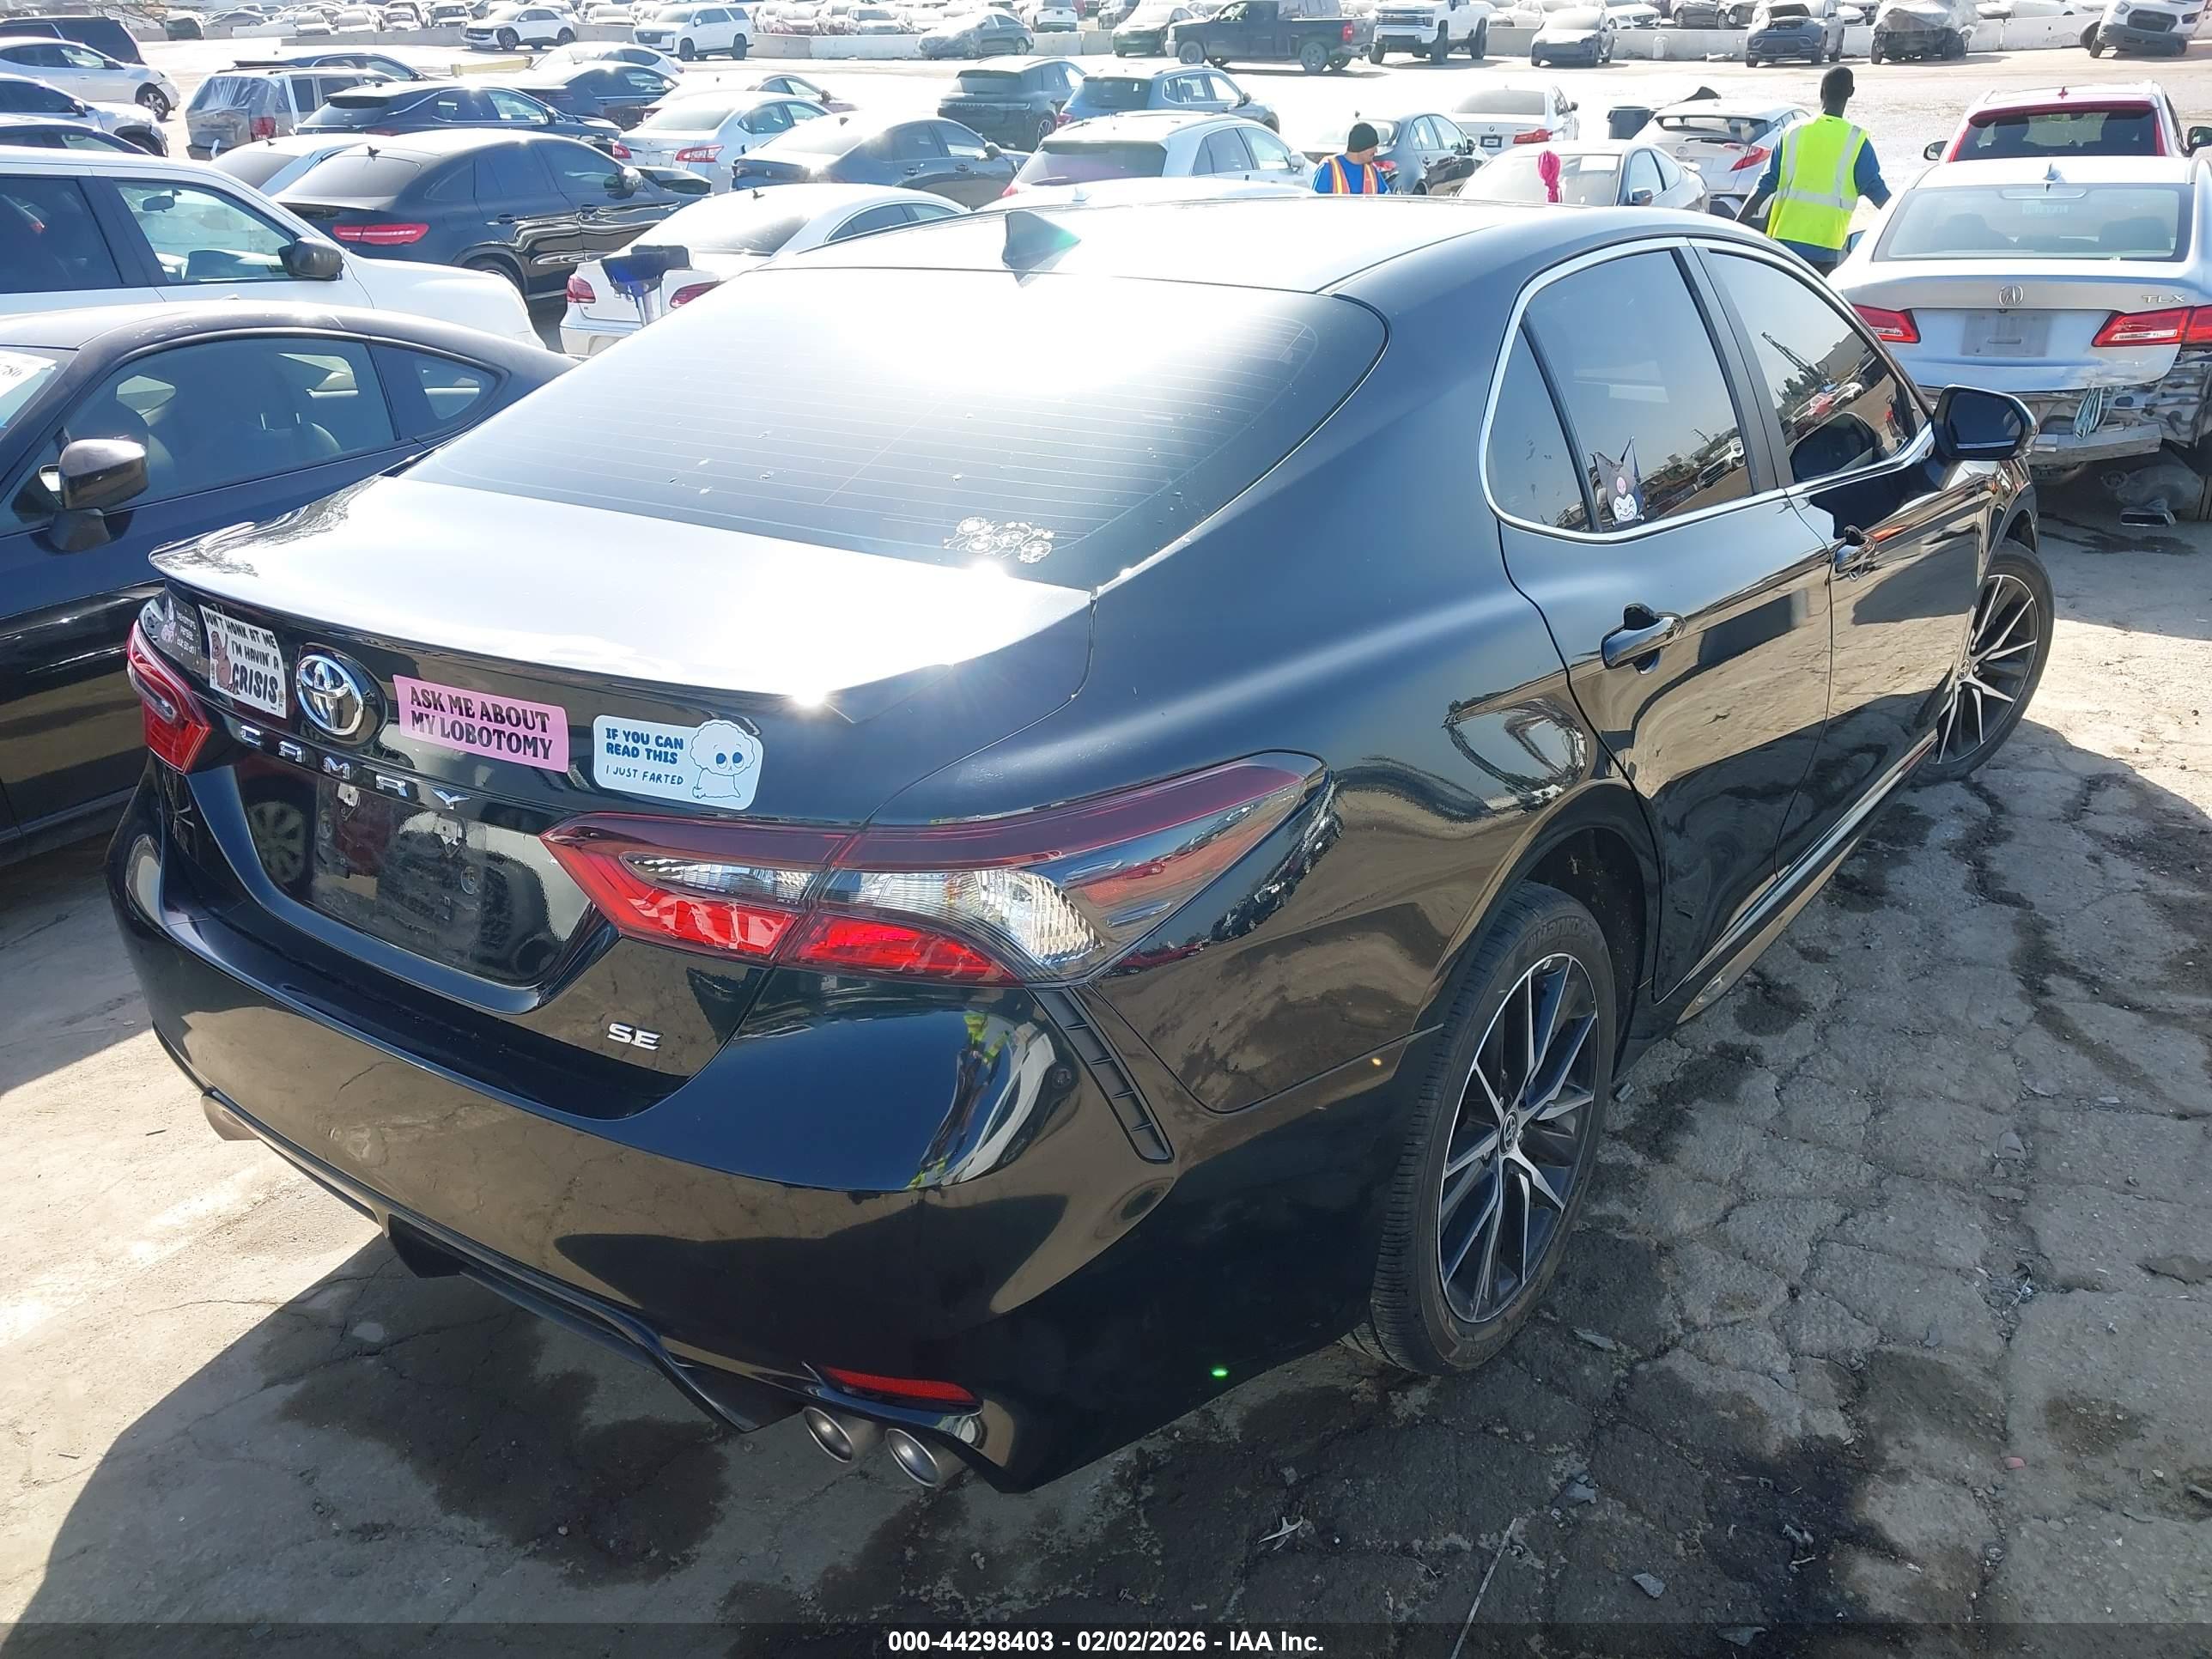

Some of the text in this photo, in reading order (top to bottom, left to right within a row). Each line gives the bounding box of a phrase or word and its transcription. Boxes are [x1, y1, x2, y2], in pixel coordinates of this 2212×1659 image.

[2142, 295, 2185, 304] TLX
[204, 611, 277, 650] DON'T HONK AT ME
[231, 640, 280, 671] I'M HAVIN' A
[232, 662, 278, 704] CRISIS
[410, 686, 550, 733] ASK ME ABOUT
[411, 710, 553, 760] MY LOBOTOMY
[605, 727, 684, 750] IF YOU CAN
[240, 725, 471, 810] CAMRY
[605, 742, 678, 764] READ THIS
[605, 764, 684, 785] I JUST FARTED
[606, 1022, 663, 1051] SE
